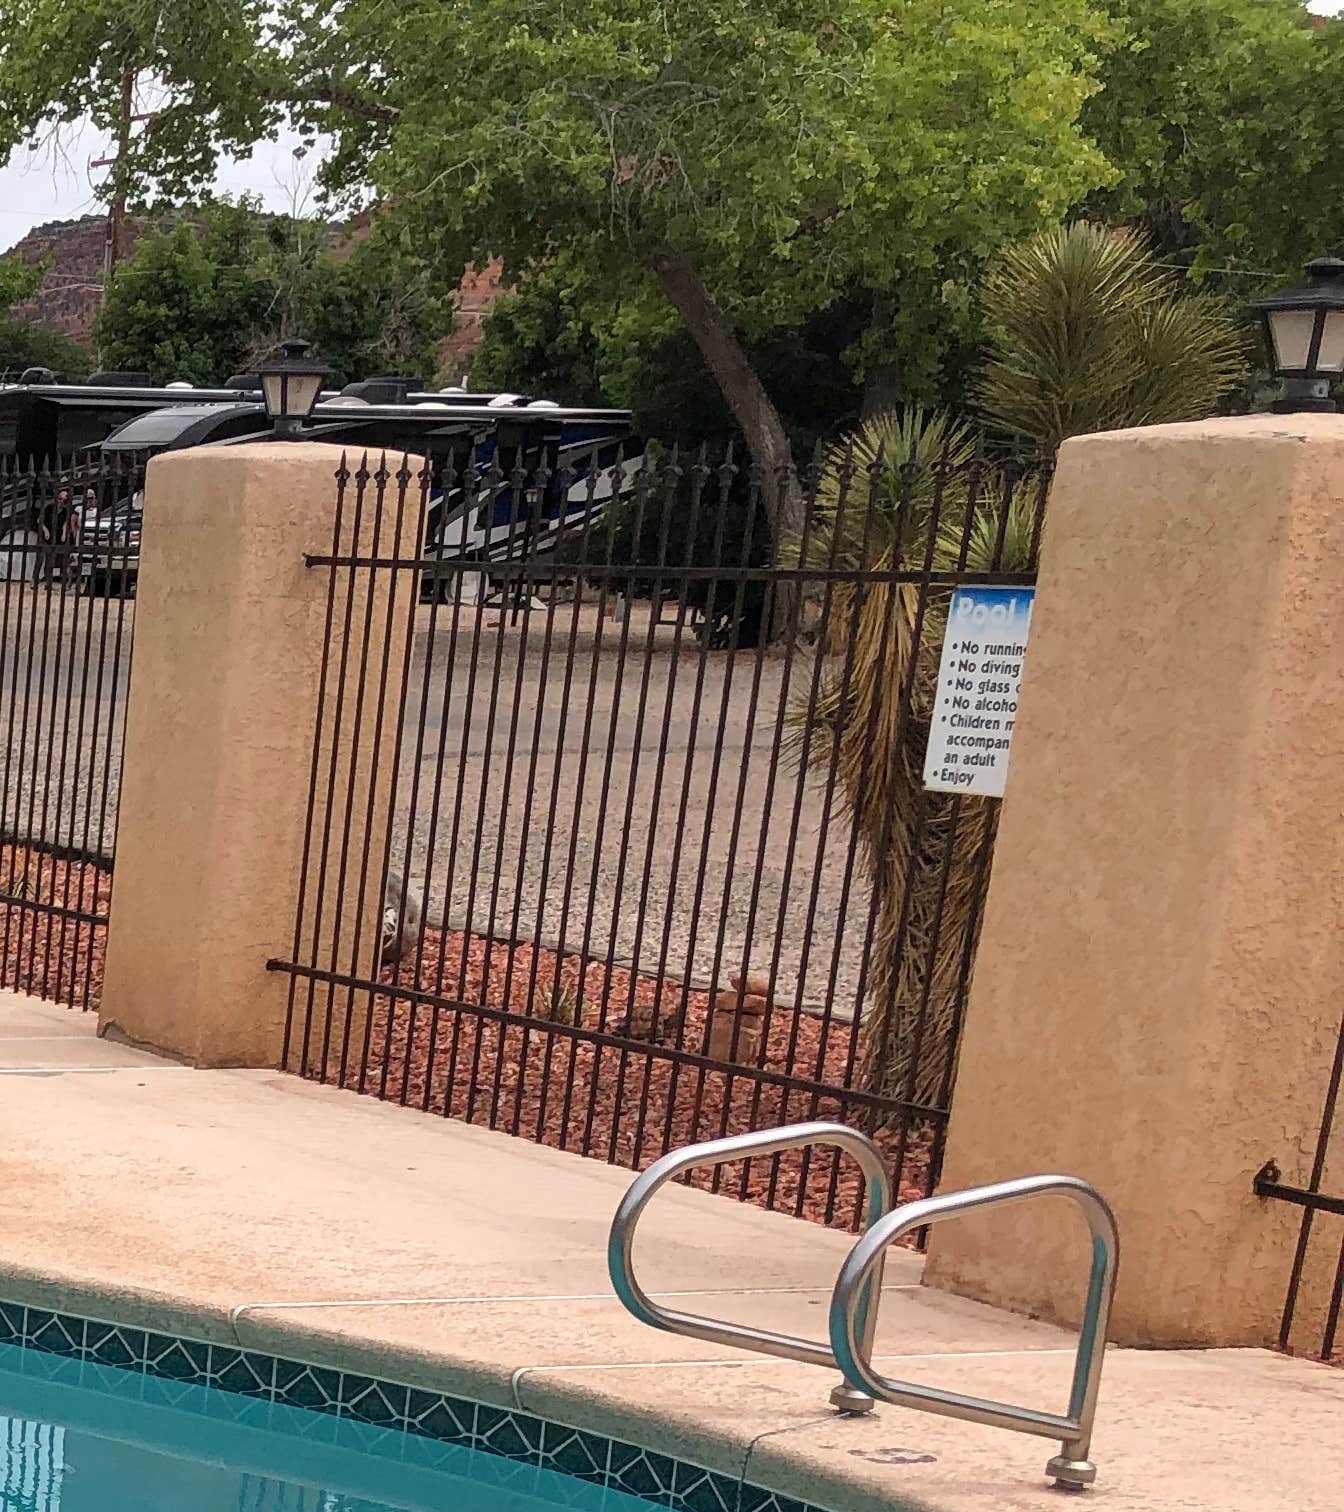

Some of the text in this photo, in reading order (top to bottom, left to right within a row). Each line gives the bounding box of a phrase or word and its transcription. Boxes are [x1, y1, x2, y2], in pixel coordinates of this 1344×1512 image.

[957, 597, 1017, 622] Pool
[961, 641, 1027, 659] No runnin
[958, 659, 1021, 678] No diving
[955, 677, 973, 691] No
[977, 678, 1010, 695] glass
[952, 695, 970, 709] No
[950, 713, 1000, 730] Children
[944, 753, 996, 767] an adult
[940, 768, 975, 786] Enjoy
